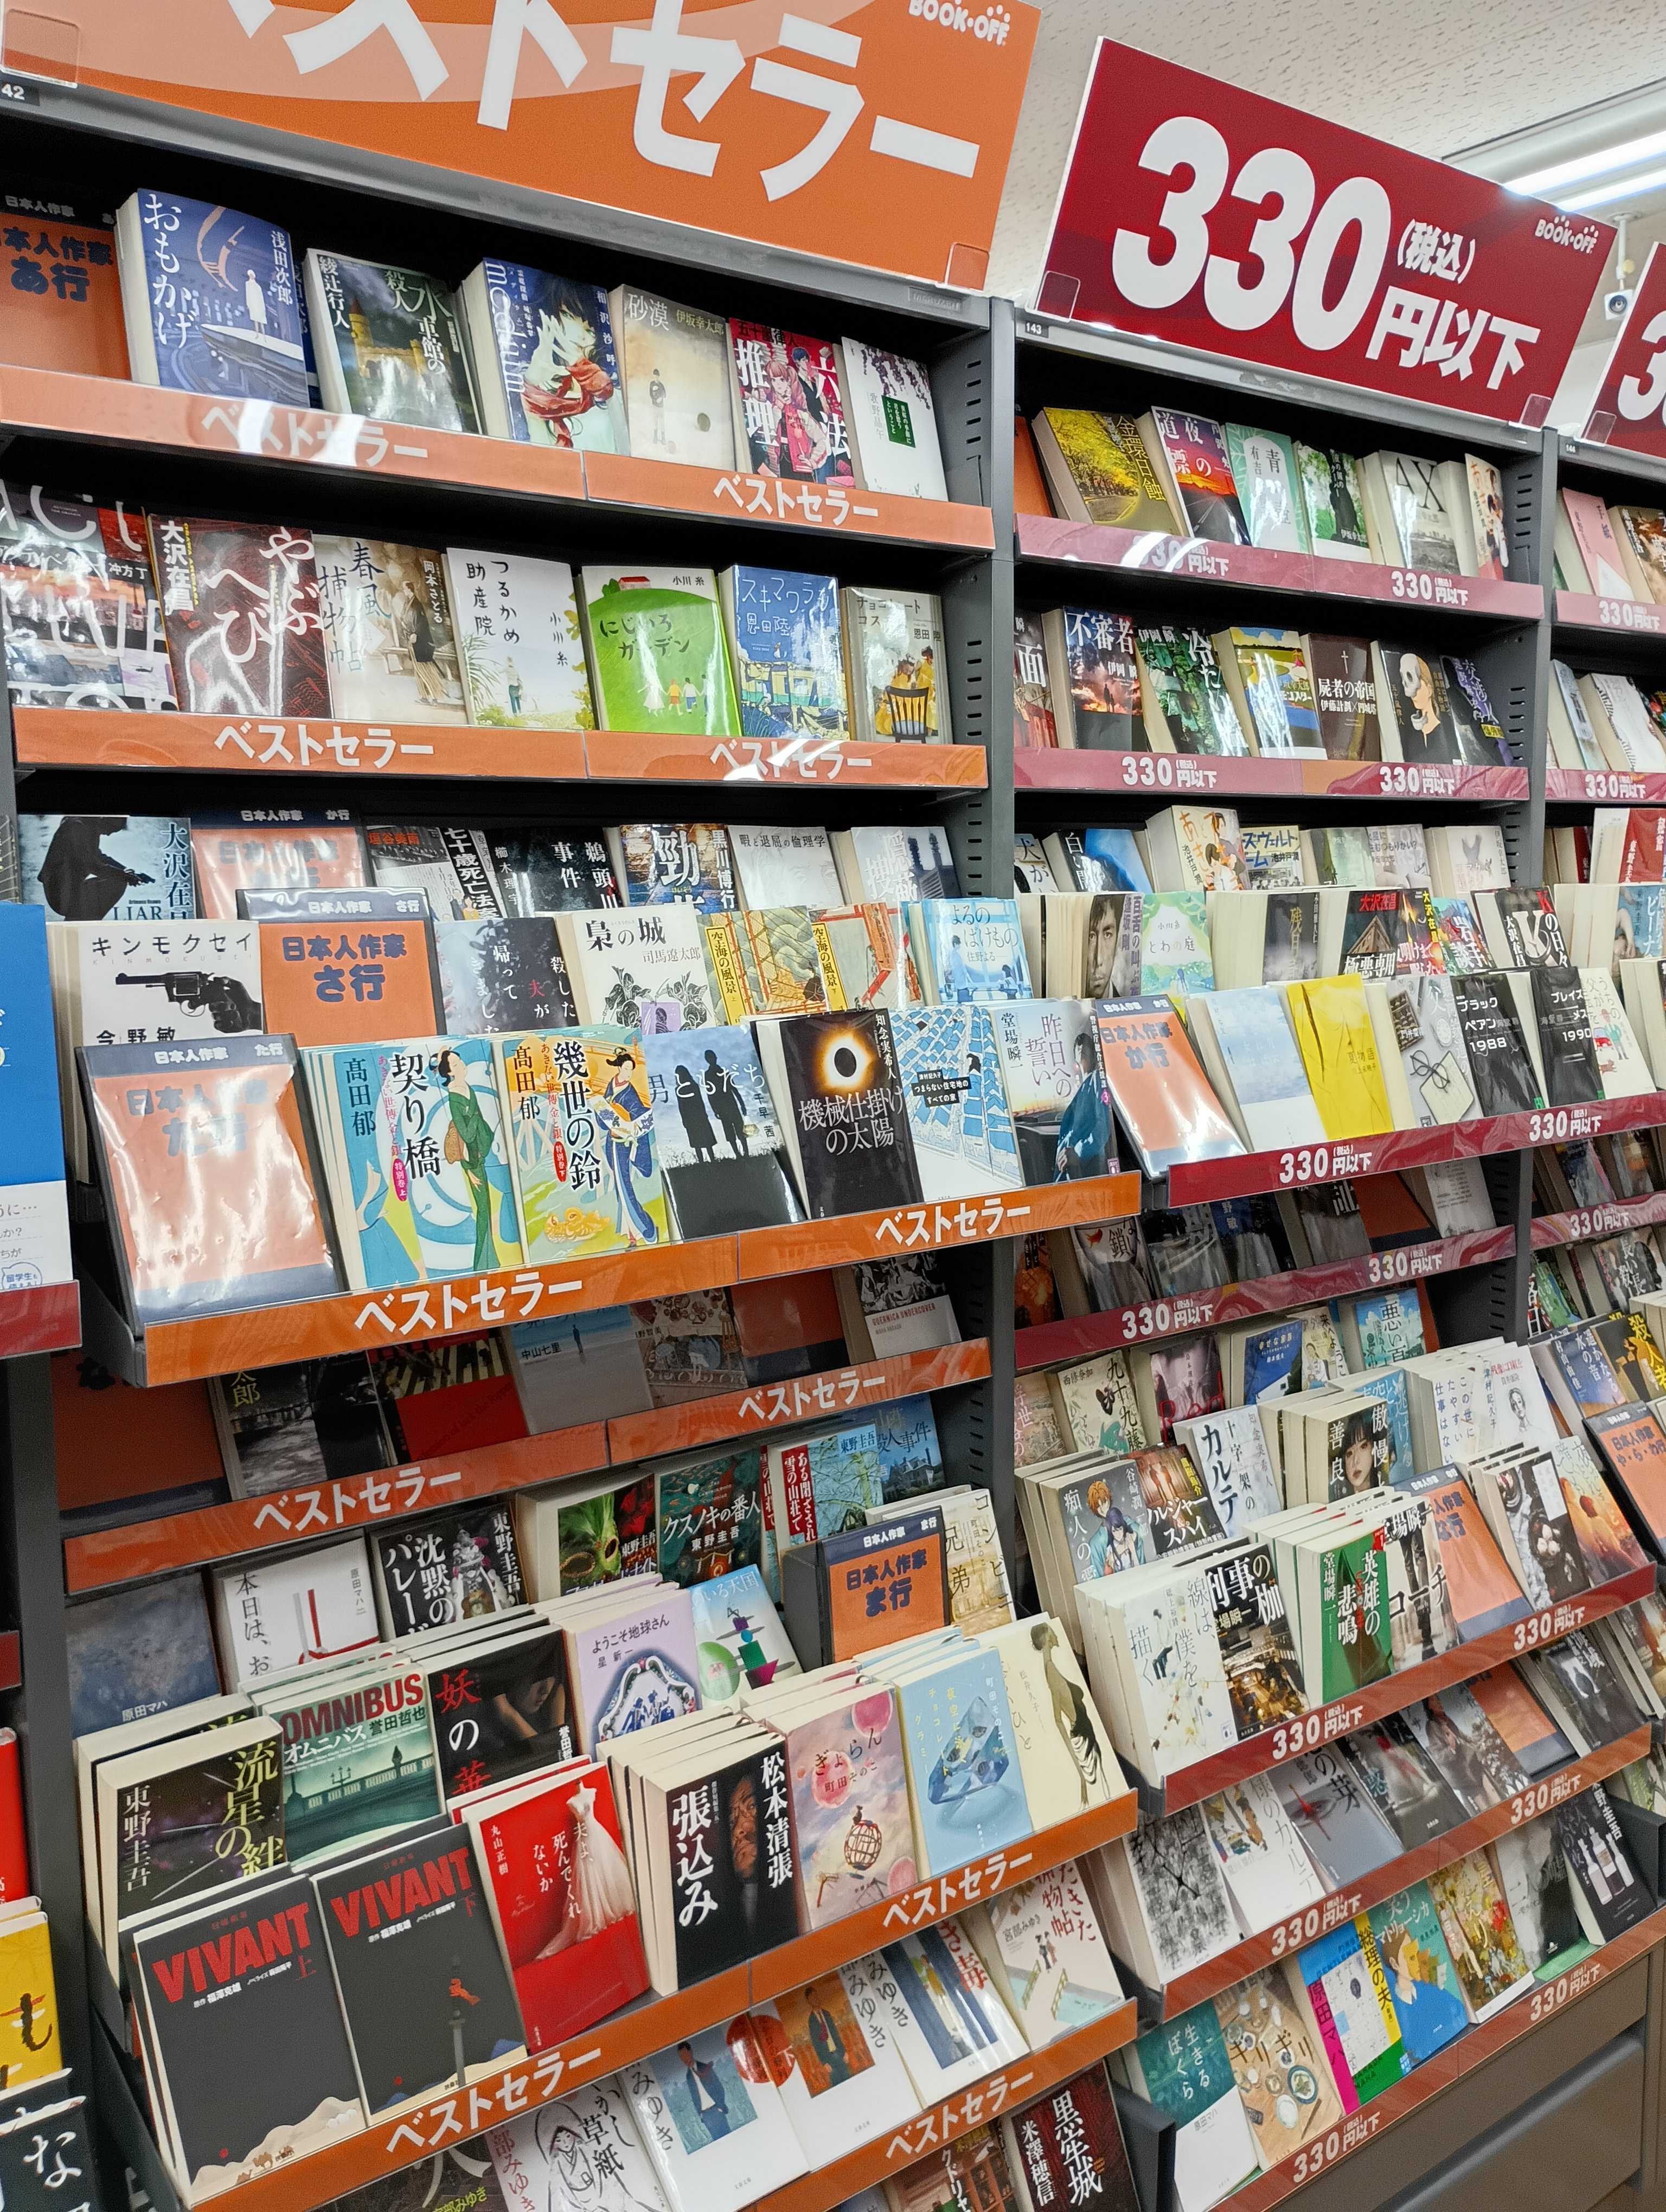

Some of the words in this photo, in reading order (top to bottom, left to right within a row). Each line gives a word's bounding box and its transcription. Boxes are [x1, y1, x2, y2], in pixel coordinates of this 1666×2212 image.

[1112, 116, 1392, 352] 330
[1397, 219, 1477, 284] (税込)
[10, 258, 90, 303] あ行
[144, 194, 194, 348] おもかげ
[271, 230, 293, 306] 浅田次郎
[386, 270, 408, 310] 殺人
[320, 256, 351, 329] 綾辻行人
[626, 293, 670, 331] 砂漠
[596, 291, 617, 368] 相沢沙呼
[676, 309, 725, 336] 伊坂幸太郎
[1024, 323, 1042, 335] 143
[1366, 286, 1541, 391] 円以下
[735, 338, 781, 447] 推理
[1116, 415, 1166, 501] 金環日蝕
[1156, 412, 1191, 476] 道標
[713, 474, 879, 526] ベストセラー
[1396, 456, 1447, 513] AX
[108, 561, 148, 580] 冲方丁
[161, 519, 195, 614] 大沢在昌
[349, 542, 392, 620] 春風
[1392, 571, 1432, 600] 330
[423, 560, 443, 624] 岡本さとる
[465, 562, 496, 638] 助産院
[490, 560, 521, 644] つるかめ
[857, 595, 921, 614] チョコート
[1599, 600, 1632, 627] 330
[549, 612, 569, 667] 小川糸
[746, 613, 791, 636] 恩田陸
[1067, 613, 1135, 655] 不審者
[618, 638, 690, 660] ガーデン
[1318, 678, 1376, 701] 屍者の帝国
[213, 721, 434, 768] ベストセラー
[710, 741, 872, 780] ベストセラー
[1123, 756, 1172, 786] 330
[1176, 770, 1218, 788] 円以下
[1380, 767, 1419, 793] 330
[1422, 776, 1455, 795] 円以下
[1585, 774, 1617, 798] 330
[241, 810, 304, 822] 日本人作家
[369, 831, 420, 845] 垣谷美雨
[739, 833, 826, 848] 暇と退屈の倫理学
[495, 847, 520, 906] 櫛木理宇
[550, 841, 581, 888] 事件
[712, 829, 735, 909] 黒川博行
[113, 905, 162, 920] LIAR
[307, 900, 372, 915] 日本人作家
[395, 899, 419, 913] さ行
[951, 904, 990, 926] よるの
[1359, 893, 1397, 912] 大沢在昌
[92, 933, 252, 957] キンモクセイ
[282, 934, 407, 962] 日本人作家
[586, 916, 667, 951] 梟の城
[642, 946, 701, 964] 司馬遼太郎
[813, 926, 837, 987] 空海の風景
[964, 928, 1019, 949] ばけもの
[1149, 936, 1196, 953] とわの庭
[313, 964, 386, 1002] さ行
[492, 945, 518, 1000] 帰って
[710, 933, 737, 994] 空海の風景
[1103, 1002, 1143, 1013] 日本人作家
[97, 1028, 176, 1044] 今野敏
[154, 1047, 229, 1064] 日本人作家
[254, 1043, 284, 1057] た行
[874, 1013, 897, 1080] 知念実希人
[1000, 1012, 1024, 1069] 堂場瞬一
[1041, 1013, 1073, 1099] 昨日への
[1100, 1021, 1173, 1044] 日本人作家
[1124, 1041, 1170, 1070] か行
[1469, 1037, 1507, 1053] 1988
[1562, 1028, 1593, 1043] 1990
[648, 1063, 766, 1104] 男ともだち
[914, 1079, 969, 1093] つまらない住宅地の
[1024, 1038, 1052, 1087] 誓い
[390, 1052, 441, 1180] 契り橋
[553, 1039, 601, 1192] 幾世の鈴
[754, 1091, 776, 1139] 千早茜
[798, 1085, 905, 1132] 機械仕掛け
[926, 1094, 957, 1104] すべての家
[825, 1116, 894, 1157] の太陽
[1529, 1110, 1567, 1142] 330
[1570, 1116, 1603, 1136] 円以下
[1279, 1147, 1328, 1184] 330
[1332, 1152, 1373, 1175] 円以下
[1333, 1145, 1354, 1156] (税込)
[875, 1196, 1031, 1248] ベストセラー
[1571, 1211, 1603, 1237] 330
[1369, 1252, 1408, 1283] 330
[1411, 1255, 1443, 1275] 円以下
[354, 1271, 582, 1336] ベストセラー
[1122, 1303, 1171, 1340] 330
[1174, 1304, 1214, 1328] 円以下
[522, 1341, 562, 1360] 中山七里
[738, 1370, 886, 1422] ベストセラー
[840, 1431, 877, 1455] 東野圭吾
[1611, 1425, 1655, 1451] 日本人作家
[1200, 1424, 1239, 1525] カルテ
[1225, 1416, 1256, 1511] 十字架の
[253, 1466, 462, 1532] ベストセラー
[663, 1490, 761, 1545] クスノキの番人
[493, 1511, 523, 1594] 東野圭吾
[621, 1531, 657, 1557] 東野圭吾
[690, 1524, 740, 1552] 東野圭吾
[863, 1524, 906, 1548] 日本人作家
[975, 1495, 1014, 1610] コンビニ
[415, 1534, 454, 1624] 沈黙の
[846, 1548, 928, 1592] 日本人作家
[1361, 1549, 1381, 1636] 英雄の
[1388, 1563, 1449, 1617] コーチ
[865, 1576, 913, 1618] ま行
[1337, 1583, 1359, 1646] 悲鳴
[592, 1613, 670, 1655] ようこそ地球さん
[1514, 1612, 1551, 1651] 330
[1554, 1607, 1586, 1634] 円以下
[121, 1701, 169, 1722] 原田マハ
[279, 1673, 425, 1746] OMNIBUS
[369, 1706, 426, 1737] 誉田哲也
[1272, 1714, 1321, 1760] 330
[1324, 1706, 1364, 1739] 円以下
[283, 1724, 368, 1766] オムニバス
[815, 1726, 883, 1777] ぎょらん
[824, 1763, 878, 1793] 町田そのこ
[216, 1740, 284, 1876] 流星の絆
[760, 1751, 793, 1889] 松本清張
[1510, 1783, 1548, 1825] 330
[123, 1784, 152, 1892] 東野圭吾
[671, 1784, 719, 1927] 張込み
[532, 1843, 554, 1893] ないか
[552, 1829, 582, 1919] 死んでくれ
[882, 1853, 1033, 1928] ベストセラー
[330, 1847, 473, 1939] VIVANT
[1272, 1908, 1319, 1956] 330
[1323, 1894, 1362, 1927] 円以下
[1375, 1901, 1431, 1945] マトリョーシカ
[152, 1901, 312, 2004] VIVANT
[296, 1954, 316, 1981] 上
[1359, 1927, 1392, 2011] 総理の夫
[1530, 1977, 1567, 2022] 330
[1570, 1963, 1601, 1996] 円以下
[1168, 2030, 1195, 2100] ぼくら
[1185, 2024, 1212, 2089] 生きる
[386, 2048, 601, 2153] ベストセラー
[886, 2072, 1034, 2158] ベストセラー
[1021, 2120, 1056, 2208] 米澤穂信
[1052, 2090, 1104, 2207] 黒牢城
[1293, 2131, 1340, 2183] 330
[1342, 2111, 1381, 2152] 円以下
